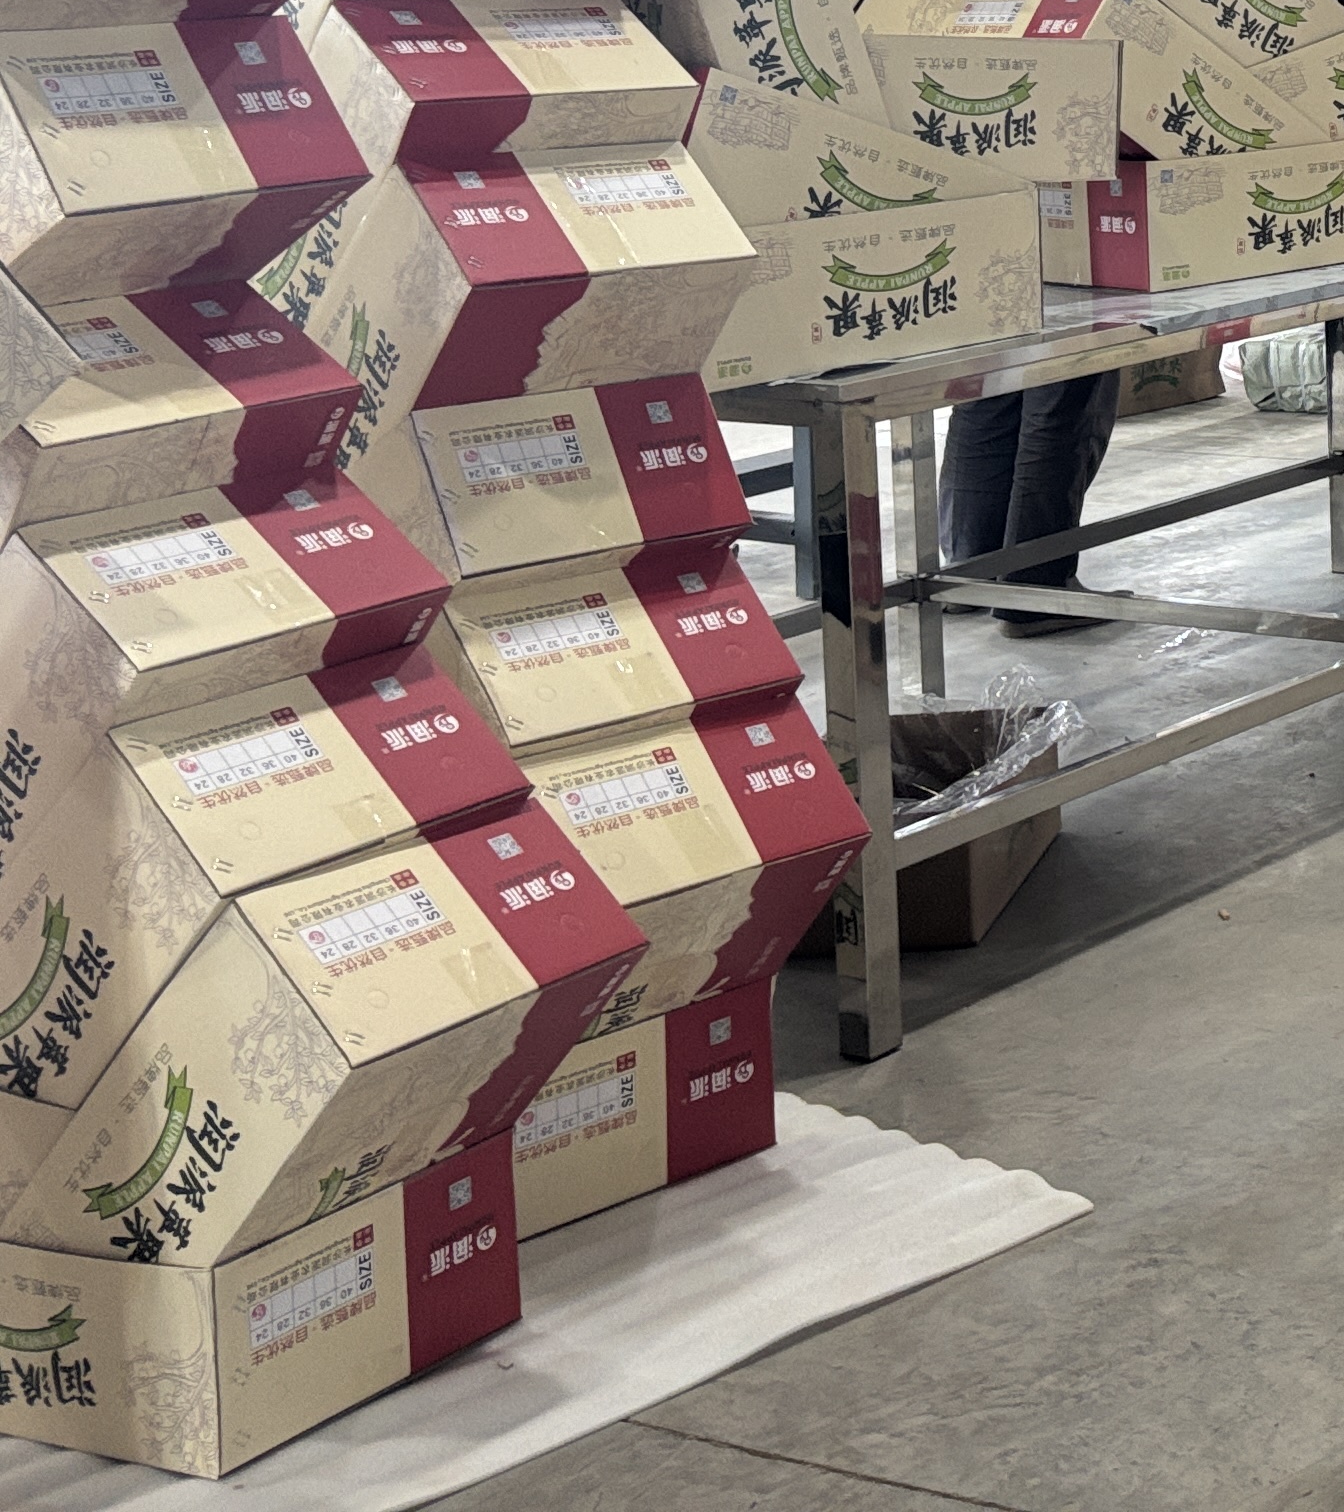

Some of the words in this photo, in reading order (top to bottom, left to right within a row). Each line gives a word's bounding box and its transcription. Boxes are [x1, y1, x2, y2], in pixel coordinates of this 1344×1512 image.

[146, 70, 179, 105] SIZE
[241, 88, 292, 115] 润派
[935, 93, 976, 114] APPLE
[977, 93, 1017, 113] RUNPAI
[912, 108, 1037, 157] 润派苹果
[663, 172, 686, 195] SIZE
[454, 205, 508, 225] 润派
[822, 275, 958, 341] 润派苹果
[106, 330, 139, 355] SIZE
[203, 332, 261, 354] 润派
[567, 434, 583, 465] SIZE
[640, 445, 687, 471] 润派
[469, 466, 593, 497] 品牌甄选·自然优生
[201, 528, 233, 557] SIZE
[294, 528, 350, 554] 润派
[596, 610, 621, 637] SIZE
[680, 606, 726, 638] 润派
[504, 638, 632, 673] 品牌甄选·自然优生
[289, 726, 319, 758] SIZE
[380, 720, 434, 754] 润派
[199, 758, 336, 809] 品牌甄选·自然优生
[666, 766, 690, 796] SIZE
[746, 764, 795, 794] 润派
[574, 796, 701, 839] 品牌甄选·自然优生
[410, 888, 441, 922] SIZE
[500, 879, 554, 912] 润派
[326, 920, 458, 978] 品牌甄选·自然优生
[620, 1073, 634, 1109] SIZE
[689, 1068, 733, 1102] 润派
[358, 1250, 373, 1293] SIZE
[429, 1236, 474, 1277] 润派
[249, 1291, 378, 1368] 品牌甄选·自然优生
